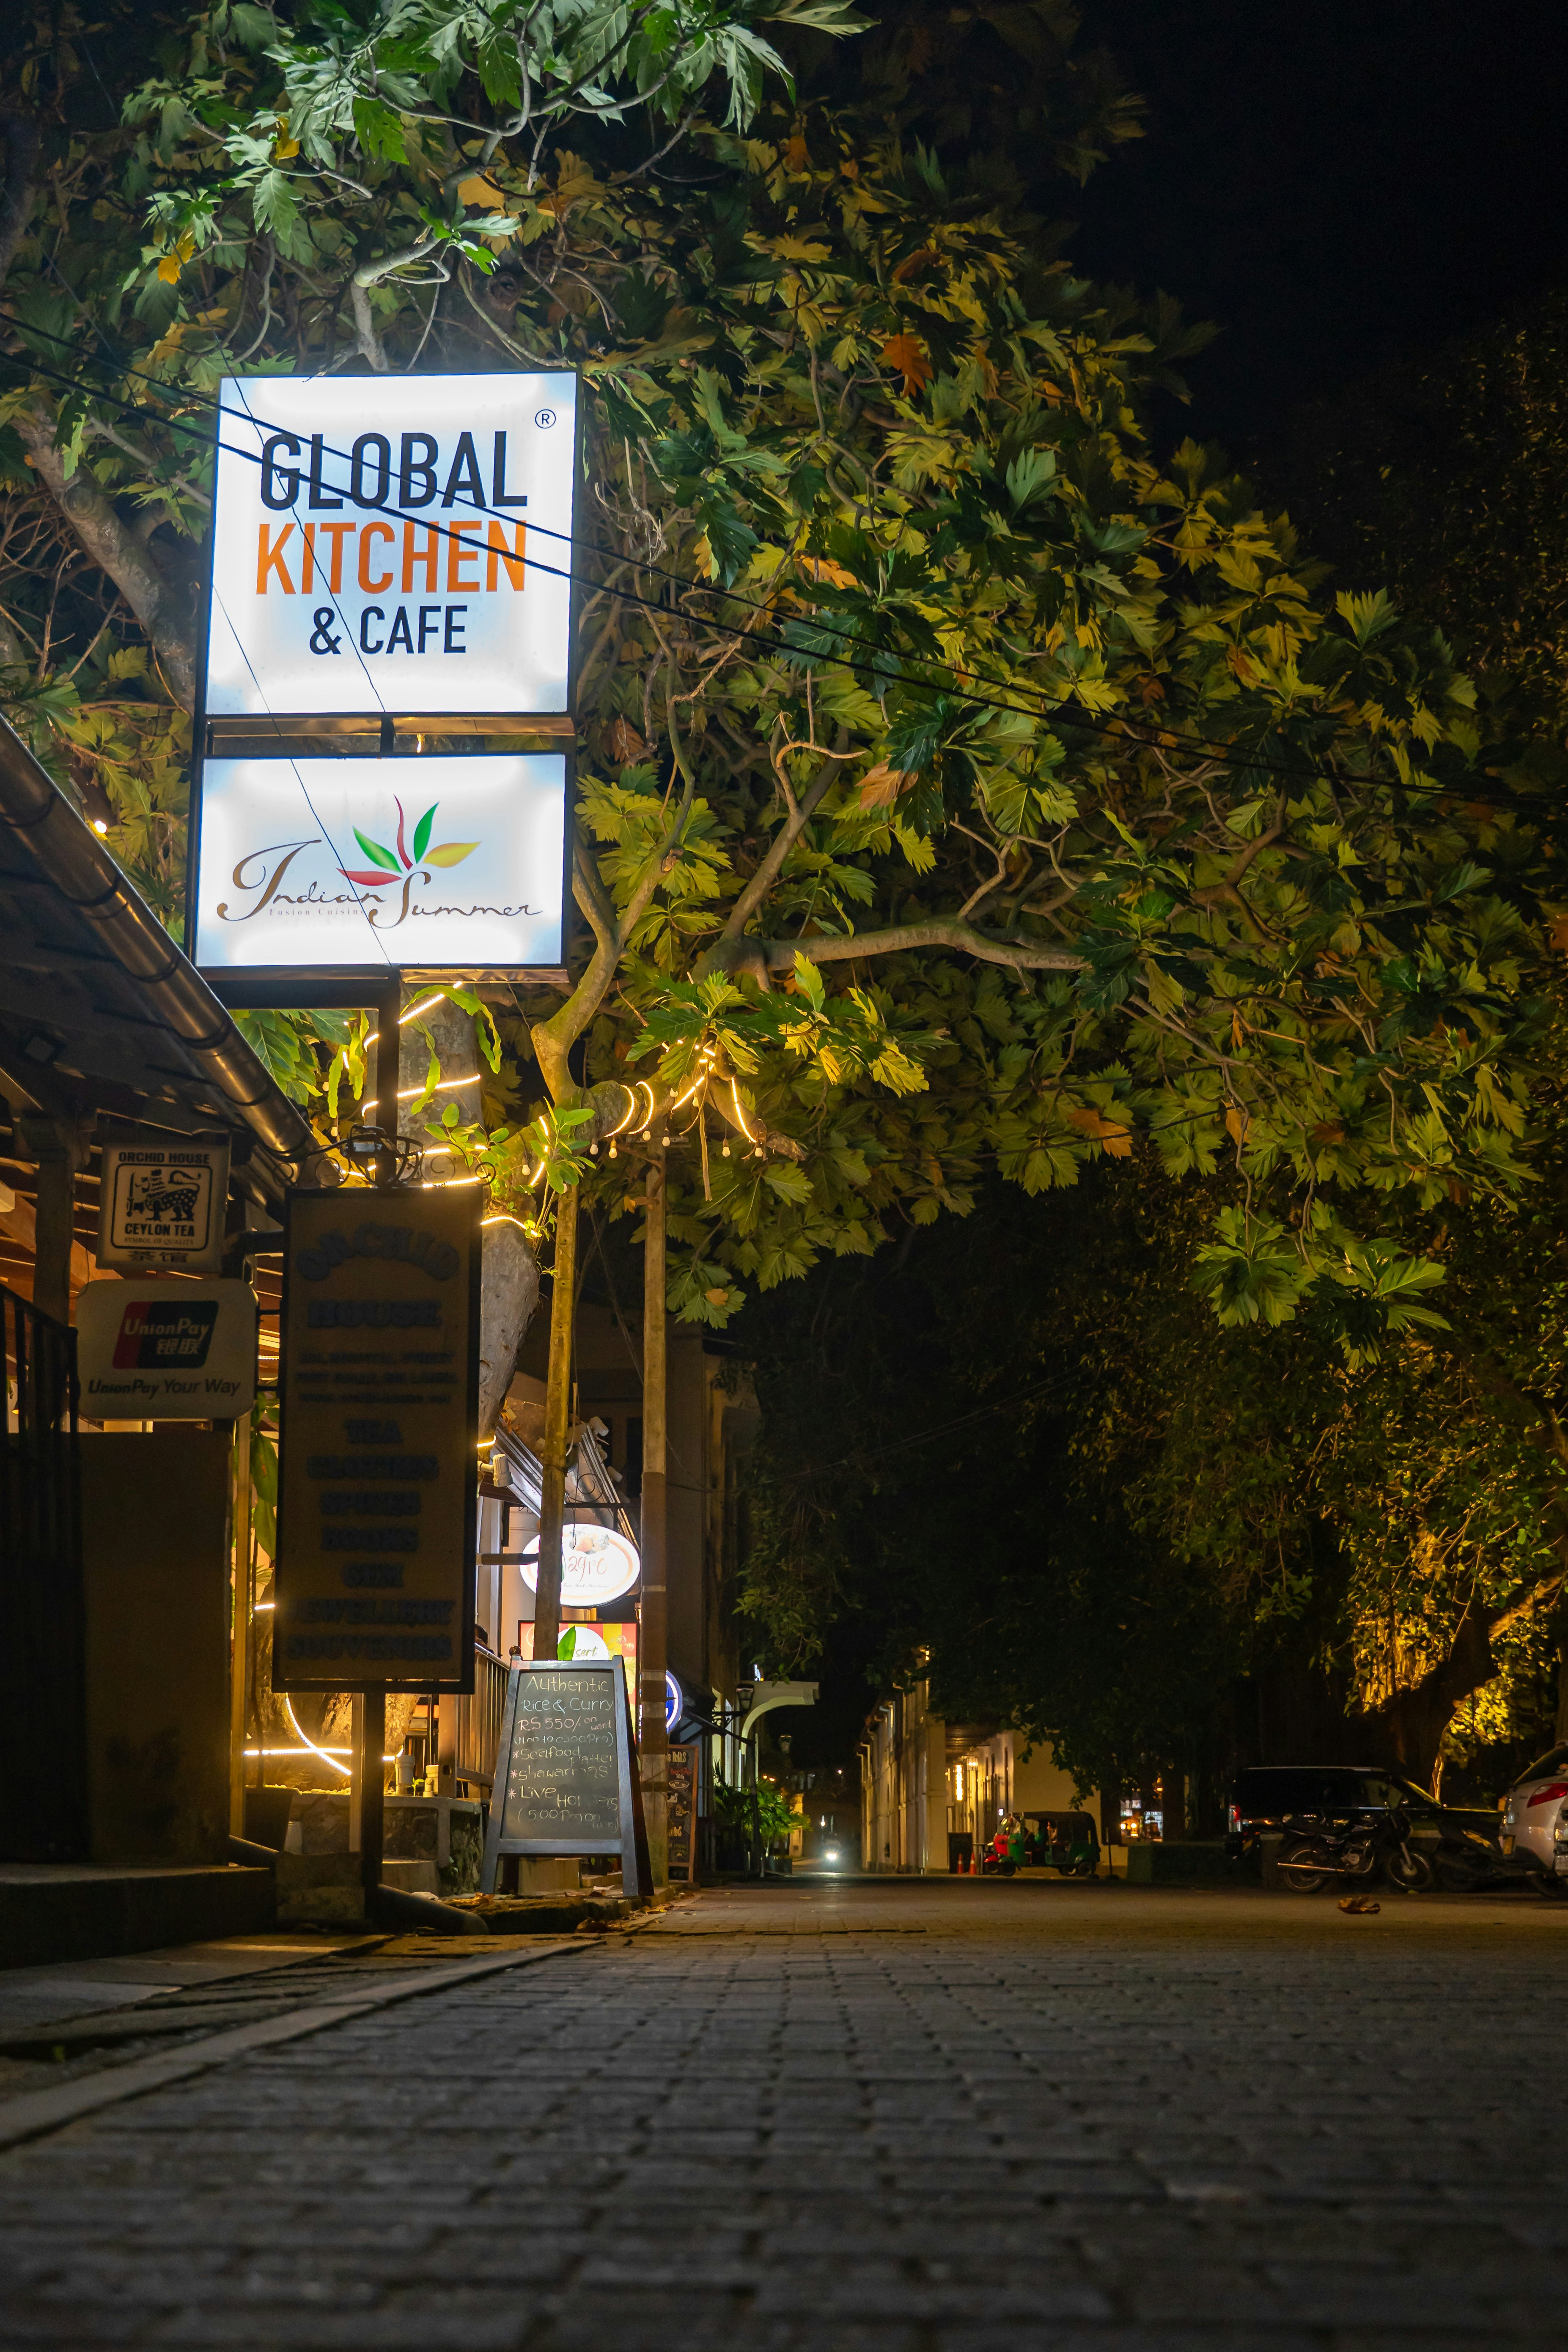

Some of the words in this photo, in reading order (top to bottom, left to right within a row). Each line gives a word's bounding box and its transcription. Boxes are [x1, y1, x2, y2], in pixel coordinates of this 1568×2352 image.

[261, 431, 527, 510] GLOBAL
[256, 520, 527, 594] KITCHEN
[309, 607, 341, 655] &
[360, 605, 467, 654] CAFE
[217, 840, 386, 921] Indian
[368, 871, 543, 929] Summer
[118, 1152, 165, 1163] ORCHID
[169, 1153, 210, 1164] HOUSE
[125, 1223, 170, 1235] CEYLON
[175, 1225, 195, 1236] TEA
[125, 1318, 210, 1342] UnionPay
[157, 1338, 201, 1355] 银联
[88, 1379, 160, 1399] UnionPay
[164, 1379, 200, 1393] Your
[205, 1378, 241, 1396] Way
[525, 1673, 609, 1692] Authentic
[521, 1699, 551, 1712] Rice
[553, 1699, 566, 1714] &
[570, 1698, 613, 1711] Curry
[521, 1746, 581, 1760] Seafood
[520, 1785, 556, 1799] Live
